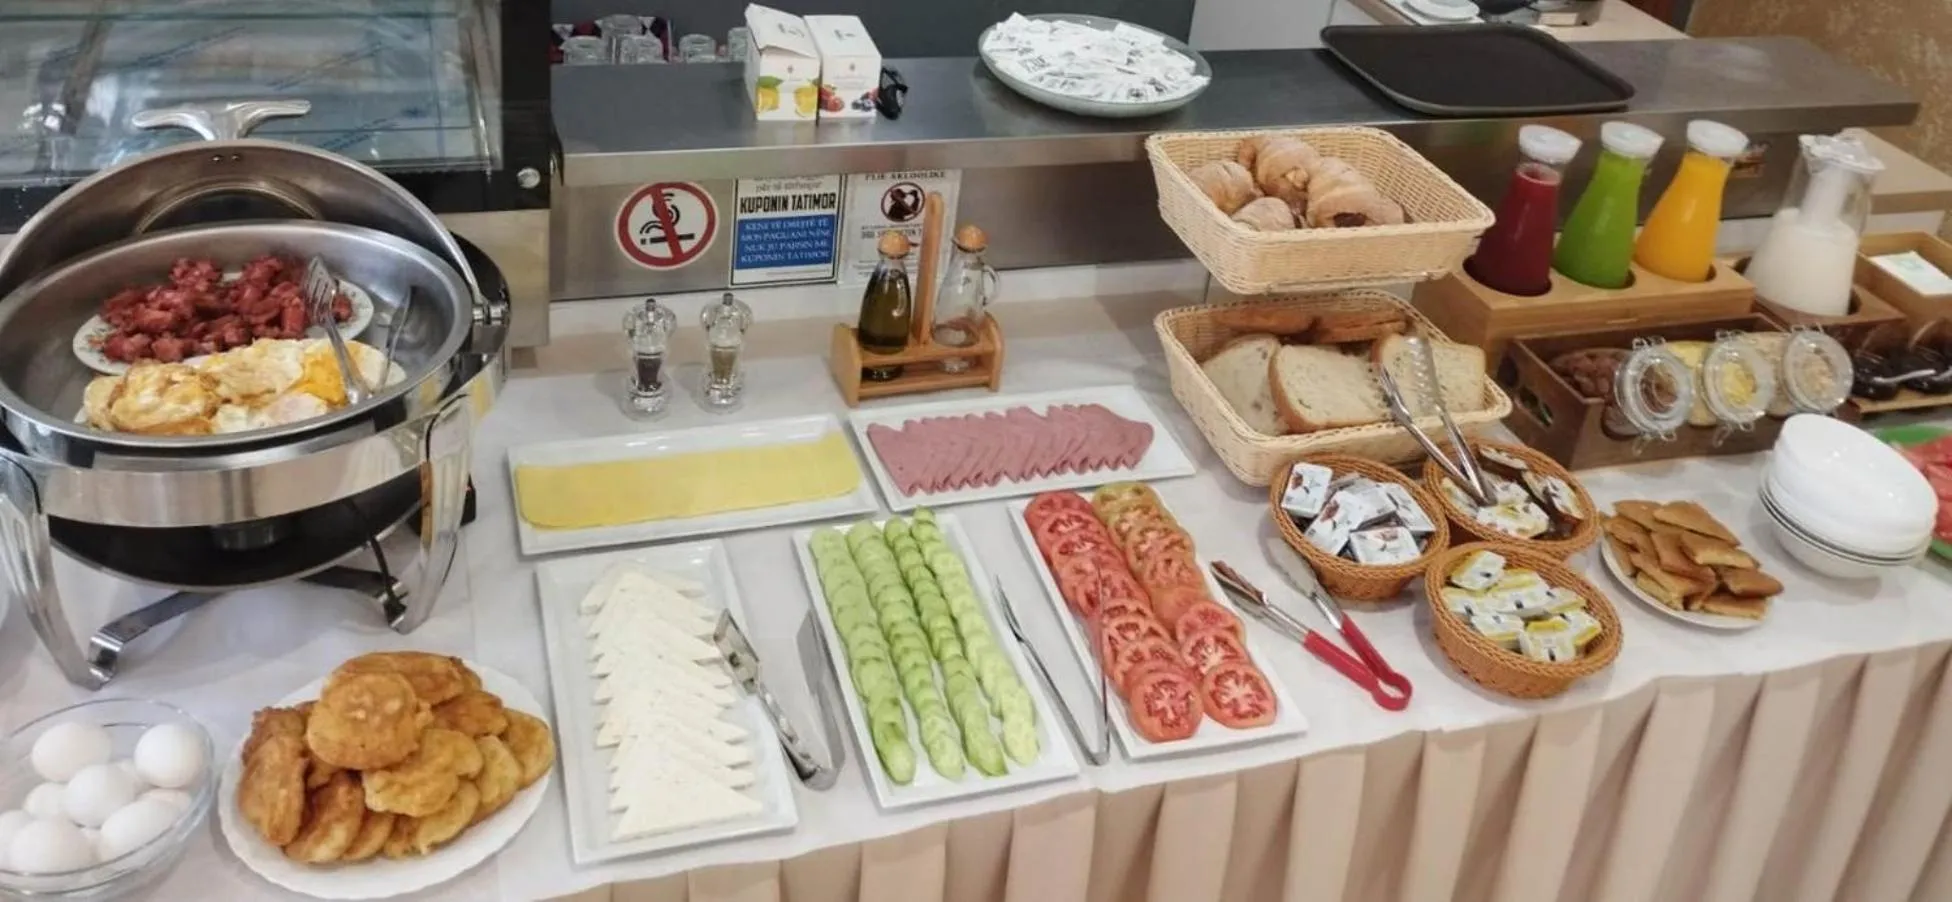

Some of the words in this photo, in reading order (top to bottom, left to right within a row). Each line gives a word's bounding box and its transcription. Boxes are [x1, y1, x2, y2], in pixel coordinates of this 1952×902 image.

[740, 195, 788, 214] KUPONIN
[791, 192, 836, 211] TATIMOR
[740, 253, 785, 263] KUPONIN
[787, 251, 830, 260] TATIMOR
